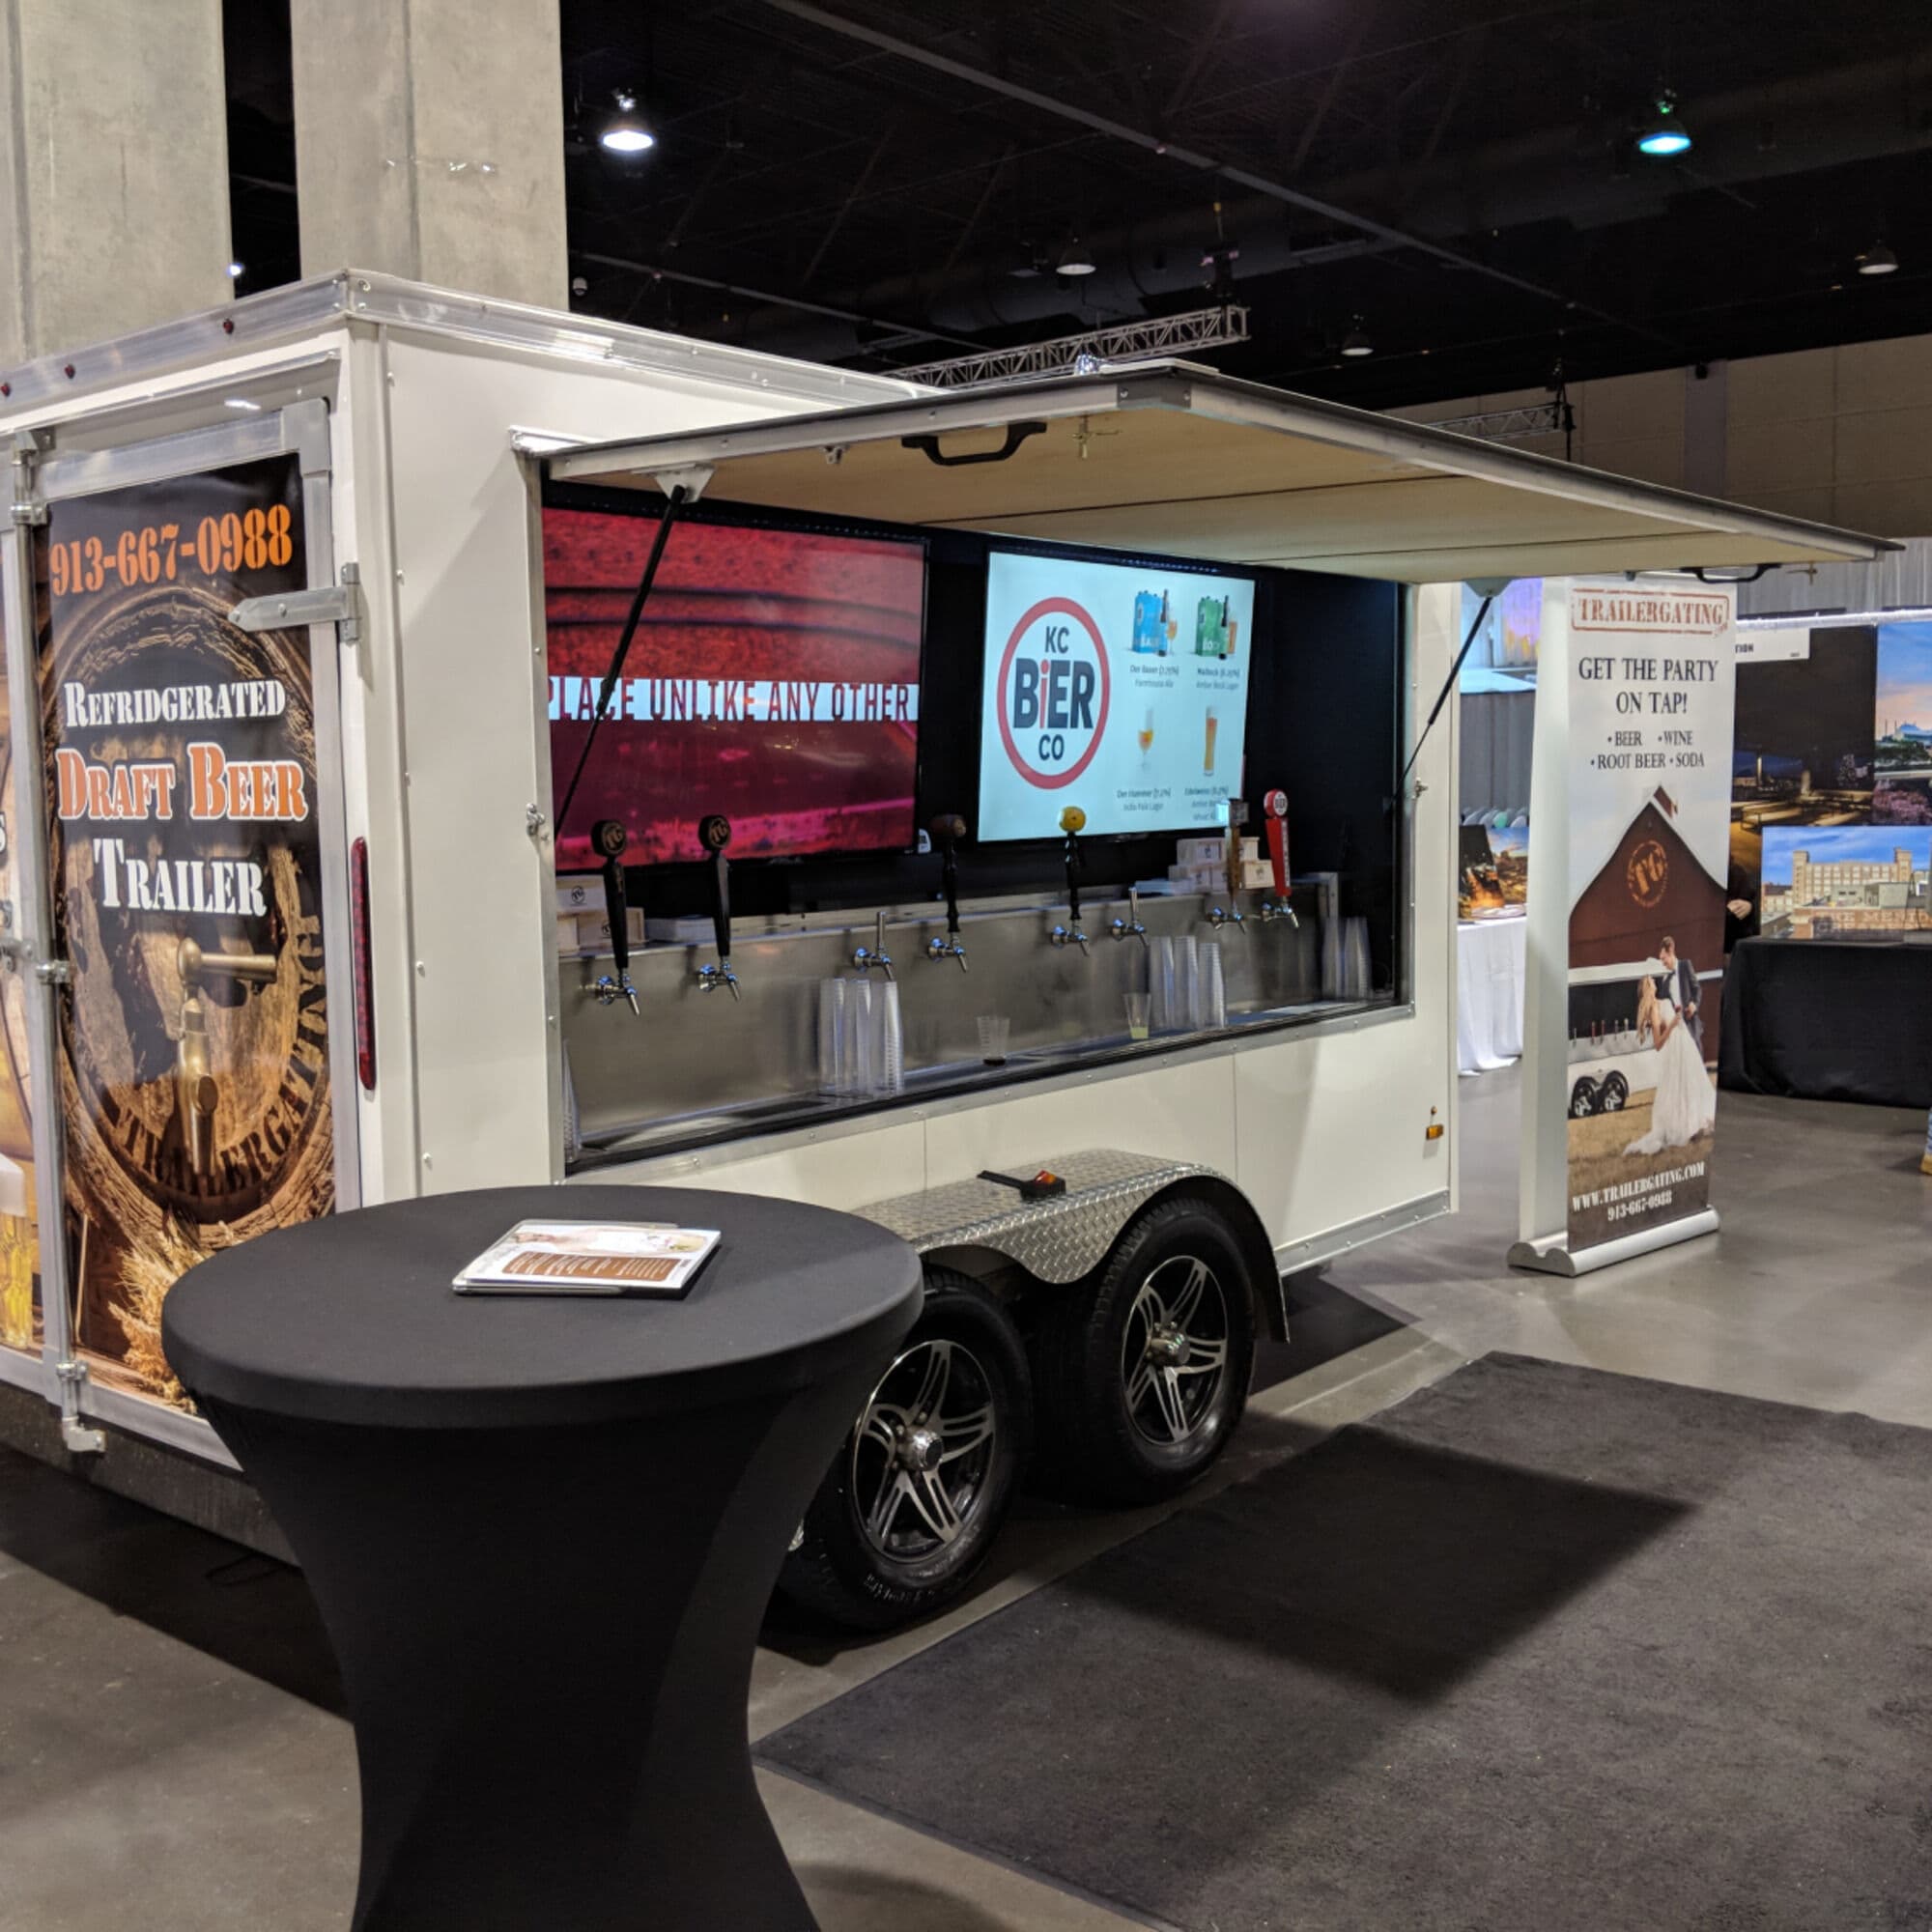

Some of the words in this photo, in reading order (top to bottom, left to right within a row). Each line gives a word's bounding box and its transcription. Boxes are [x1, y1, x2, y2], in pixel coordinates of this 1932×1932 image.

[51, 504, 292, 596] 913-667-0988
[1579, 598, 1723, 625] TRAILERGATING
[1045, 626, 1069, 653] KC
[1578, 657, 1615, 680] GET
[1622, 658, 1657, 680] THE
[1663, 659, 1719, 682] PARTY
[64, 679, 286, 727] REFRIDGERATED
[649, 679, 755, 722] UNLIKE
[768, 681, 819, 722] ANY
[832, 683, 909, 722] OTHER
[1616, 691, 1641, 714] ON
[1648, 692, 1688, 714] TAP!
[1038, 734, 1065, 761] CO
[1615, 731, 1642, 747] BEER
[1663, 730, 1692, 746] WINE
[1598, 753, 1631, 769] ROOT
[1635, 753, 1665, 768] BEER
[1676, 752, 1705, 768] SODA
[55, 748, 176, 820] DRAFT
[187, 742, 308, 821] BEER
[93, 838, 267, 917] TRAILER
[1572, 1161, 1706, 1212] WWW.TRAILERGATING.COM
